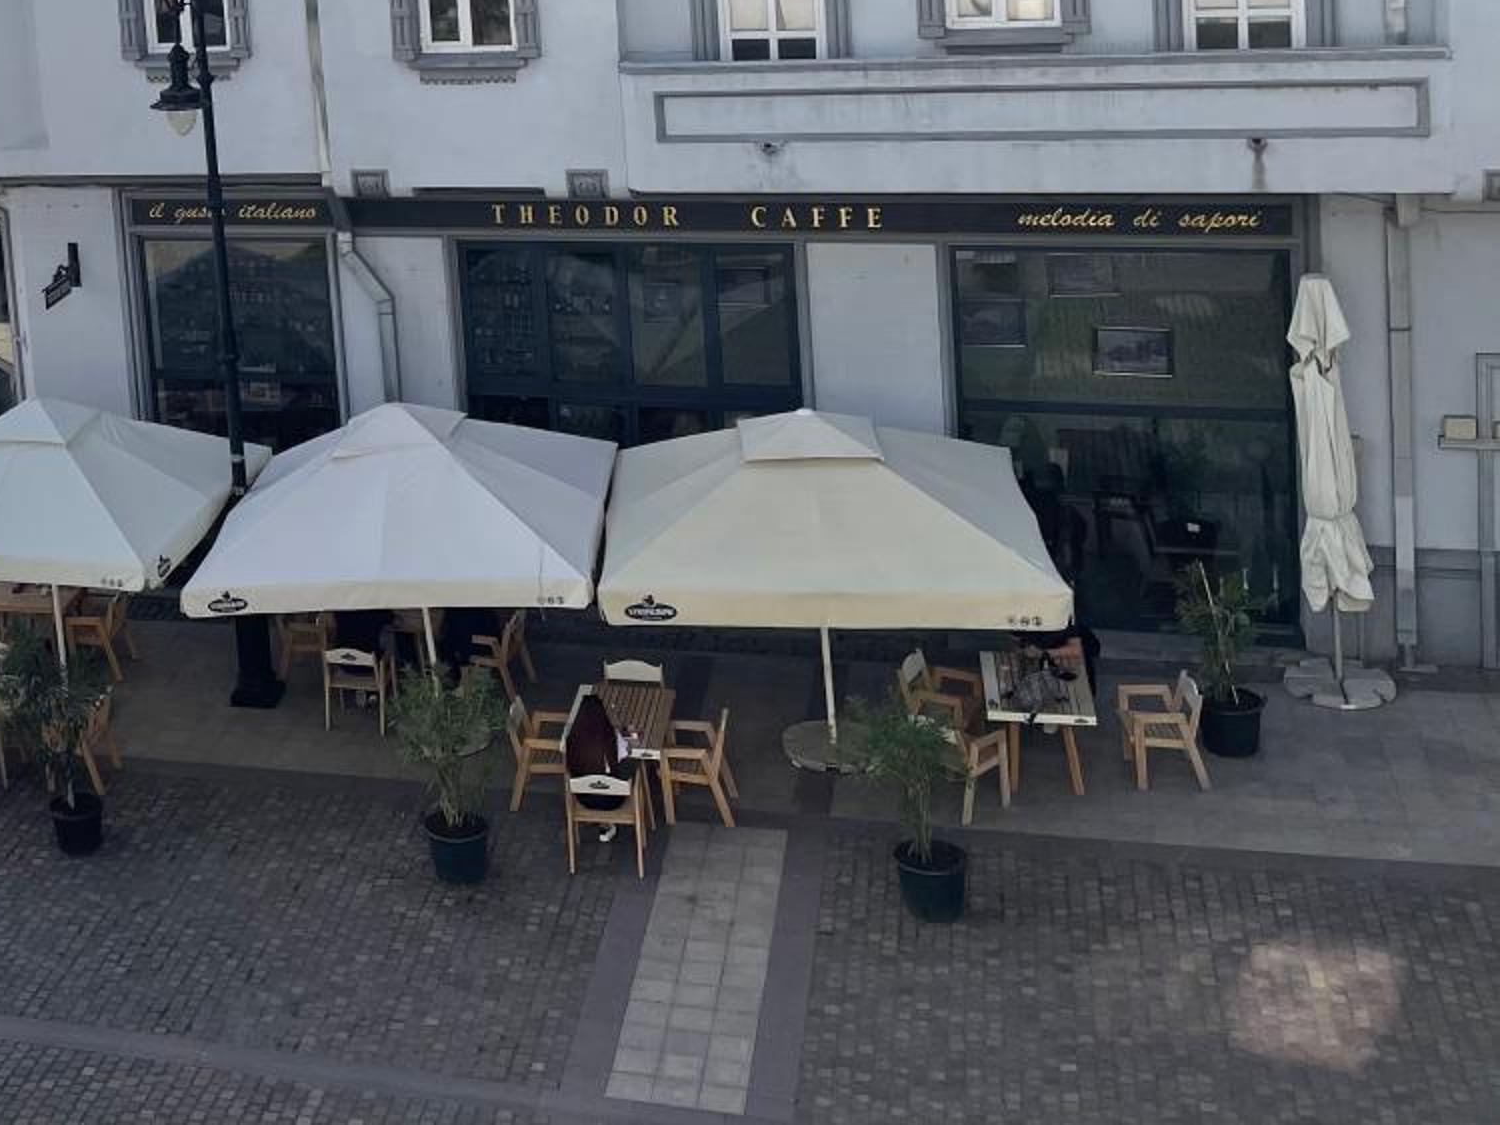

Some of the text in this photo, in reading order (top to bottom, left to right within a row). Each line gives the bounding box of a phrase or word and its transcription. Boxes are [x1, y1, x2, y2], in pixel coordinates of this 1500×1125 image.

[150, 202, 165, 218] il
[238, 202, 317, 220] italiano
[491, 203, 883, 229] THEODOR CAFFE
[1017, 207, 1264, 233] melodia di sapori
